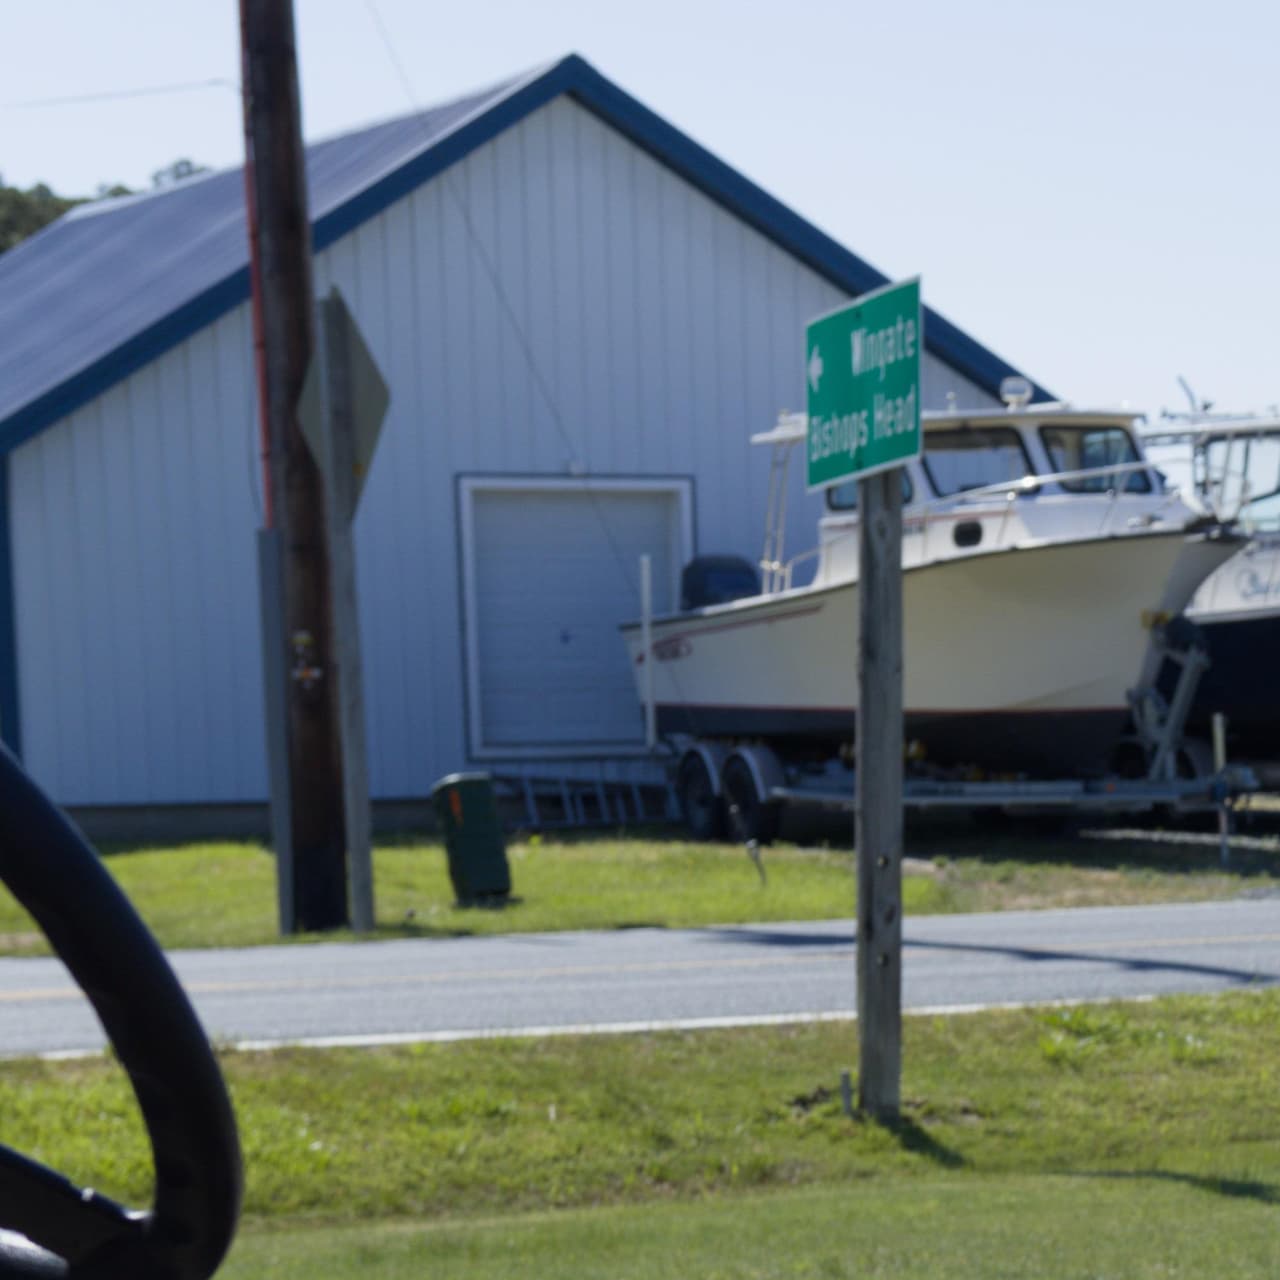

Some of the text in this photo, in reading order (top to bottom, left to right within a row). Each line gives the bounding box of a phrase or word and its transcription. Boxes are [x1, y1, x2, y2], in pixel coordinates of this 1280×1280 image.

[851, 315, 915, 382] Wingate
[811, 384, 915, 463] Bishops Head
